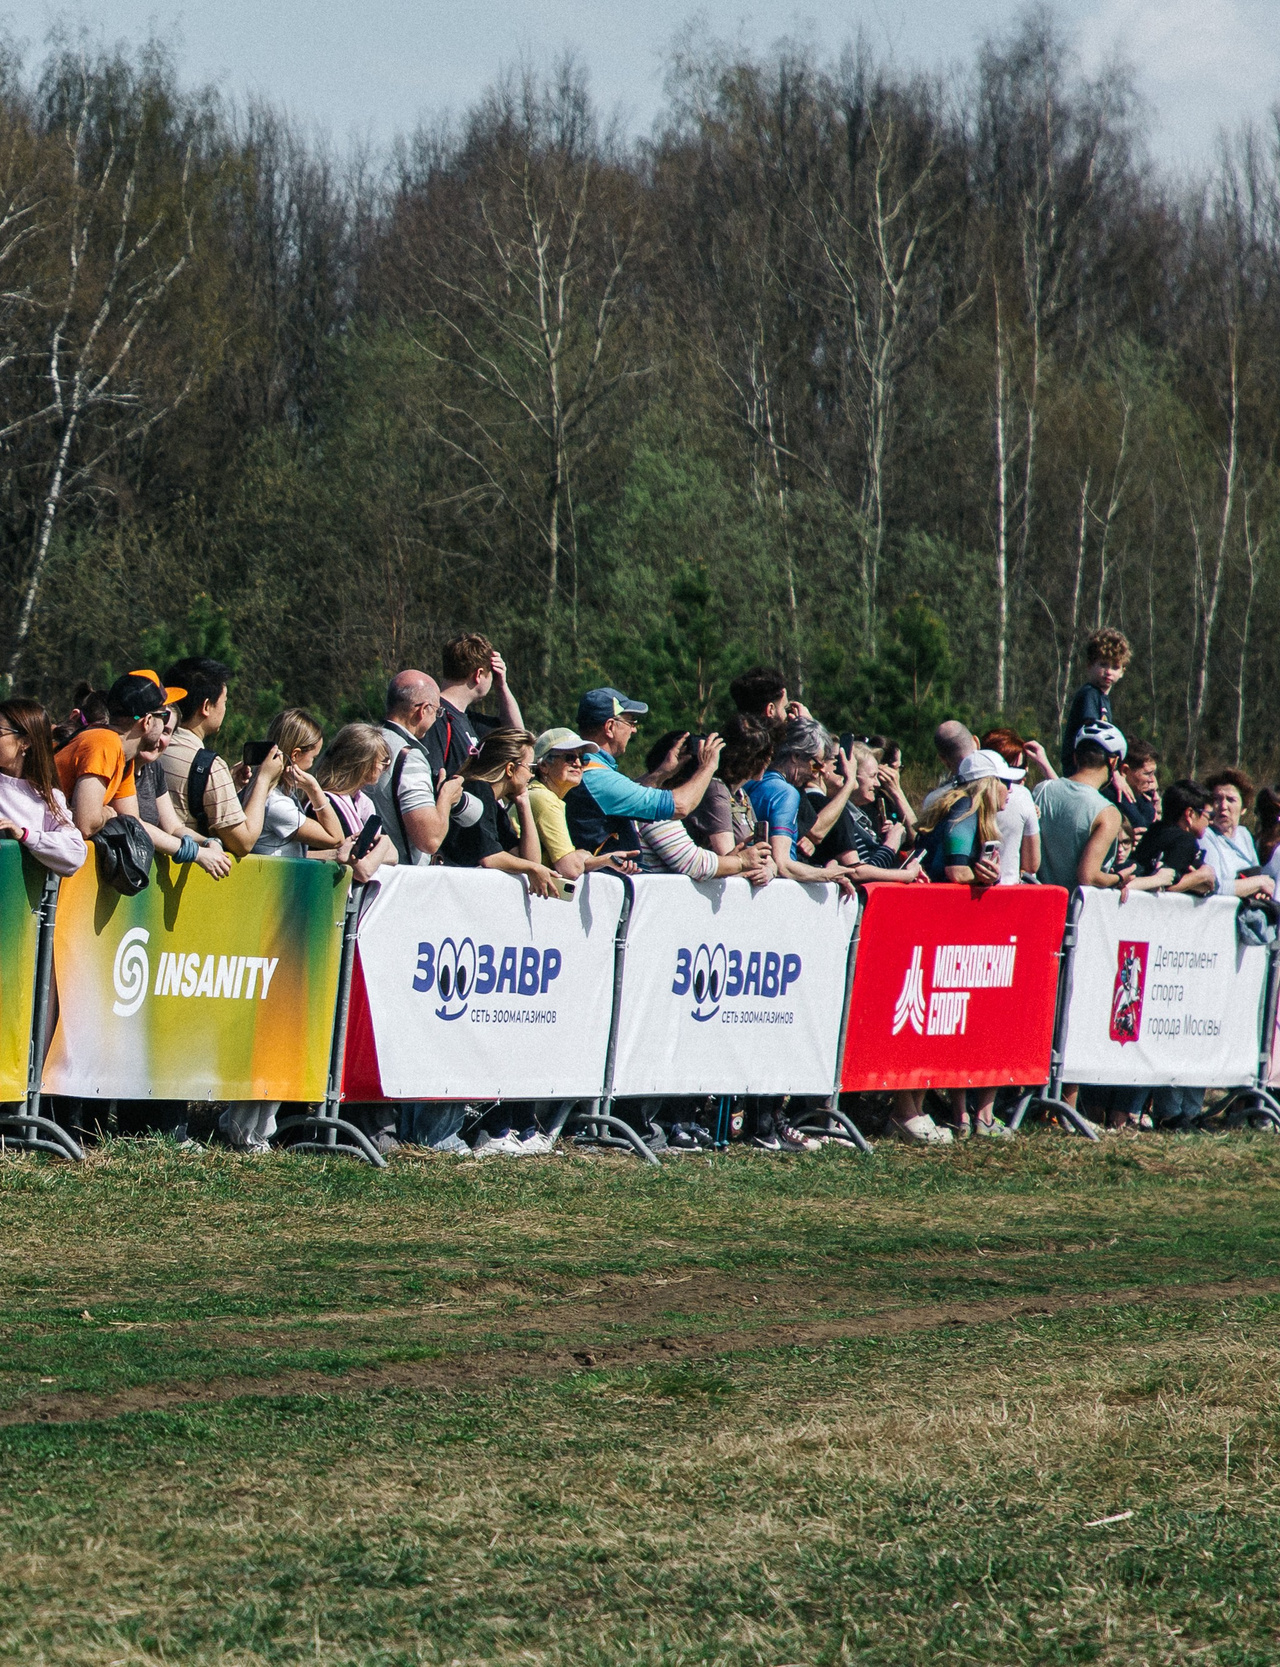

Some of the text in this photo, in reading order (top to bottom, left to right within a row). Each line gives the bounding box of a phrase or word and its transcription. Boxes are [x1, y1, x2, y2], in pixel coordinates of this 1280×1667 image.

[154, 952, 280, 1000] INSANITY
[412, 937, 562, 1002] ЗООЗАВР
[671, 942, 802, 1004] ЗООЗАВР
[932, 935, 1017, 988] МОСКОВСКИЙ
[1153, 945, 1218, 974] Департамент
[926, 992, 970, 1035] СПОРТ
[1151, 984, 1184, 1007] спорта
[470, 1009, 557, 1024] СЕТЬ ЗООМАГАЗИНОВ
[721, 1010, 794, 1024] СЕТЬ ЗООМАГАЗИНОВ
[1147, 1014, 1222, 1041] города Москвы
